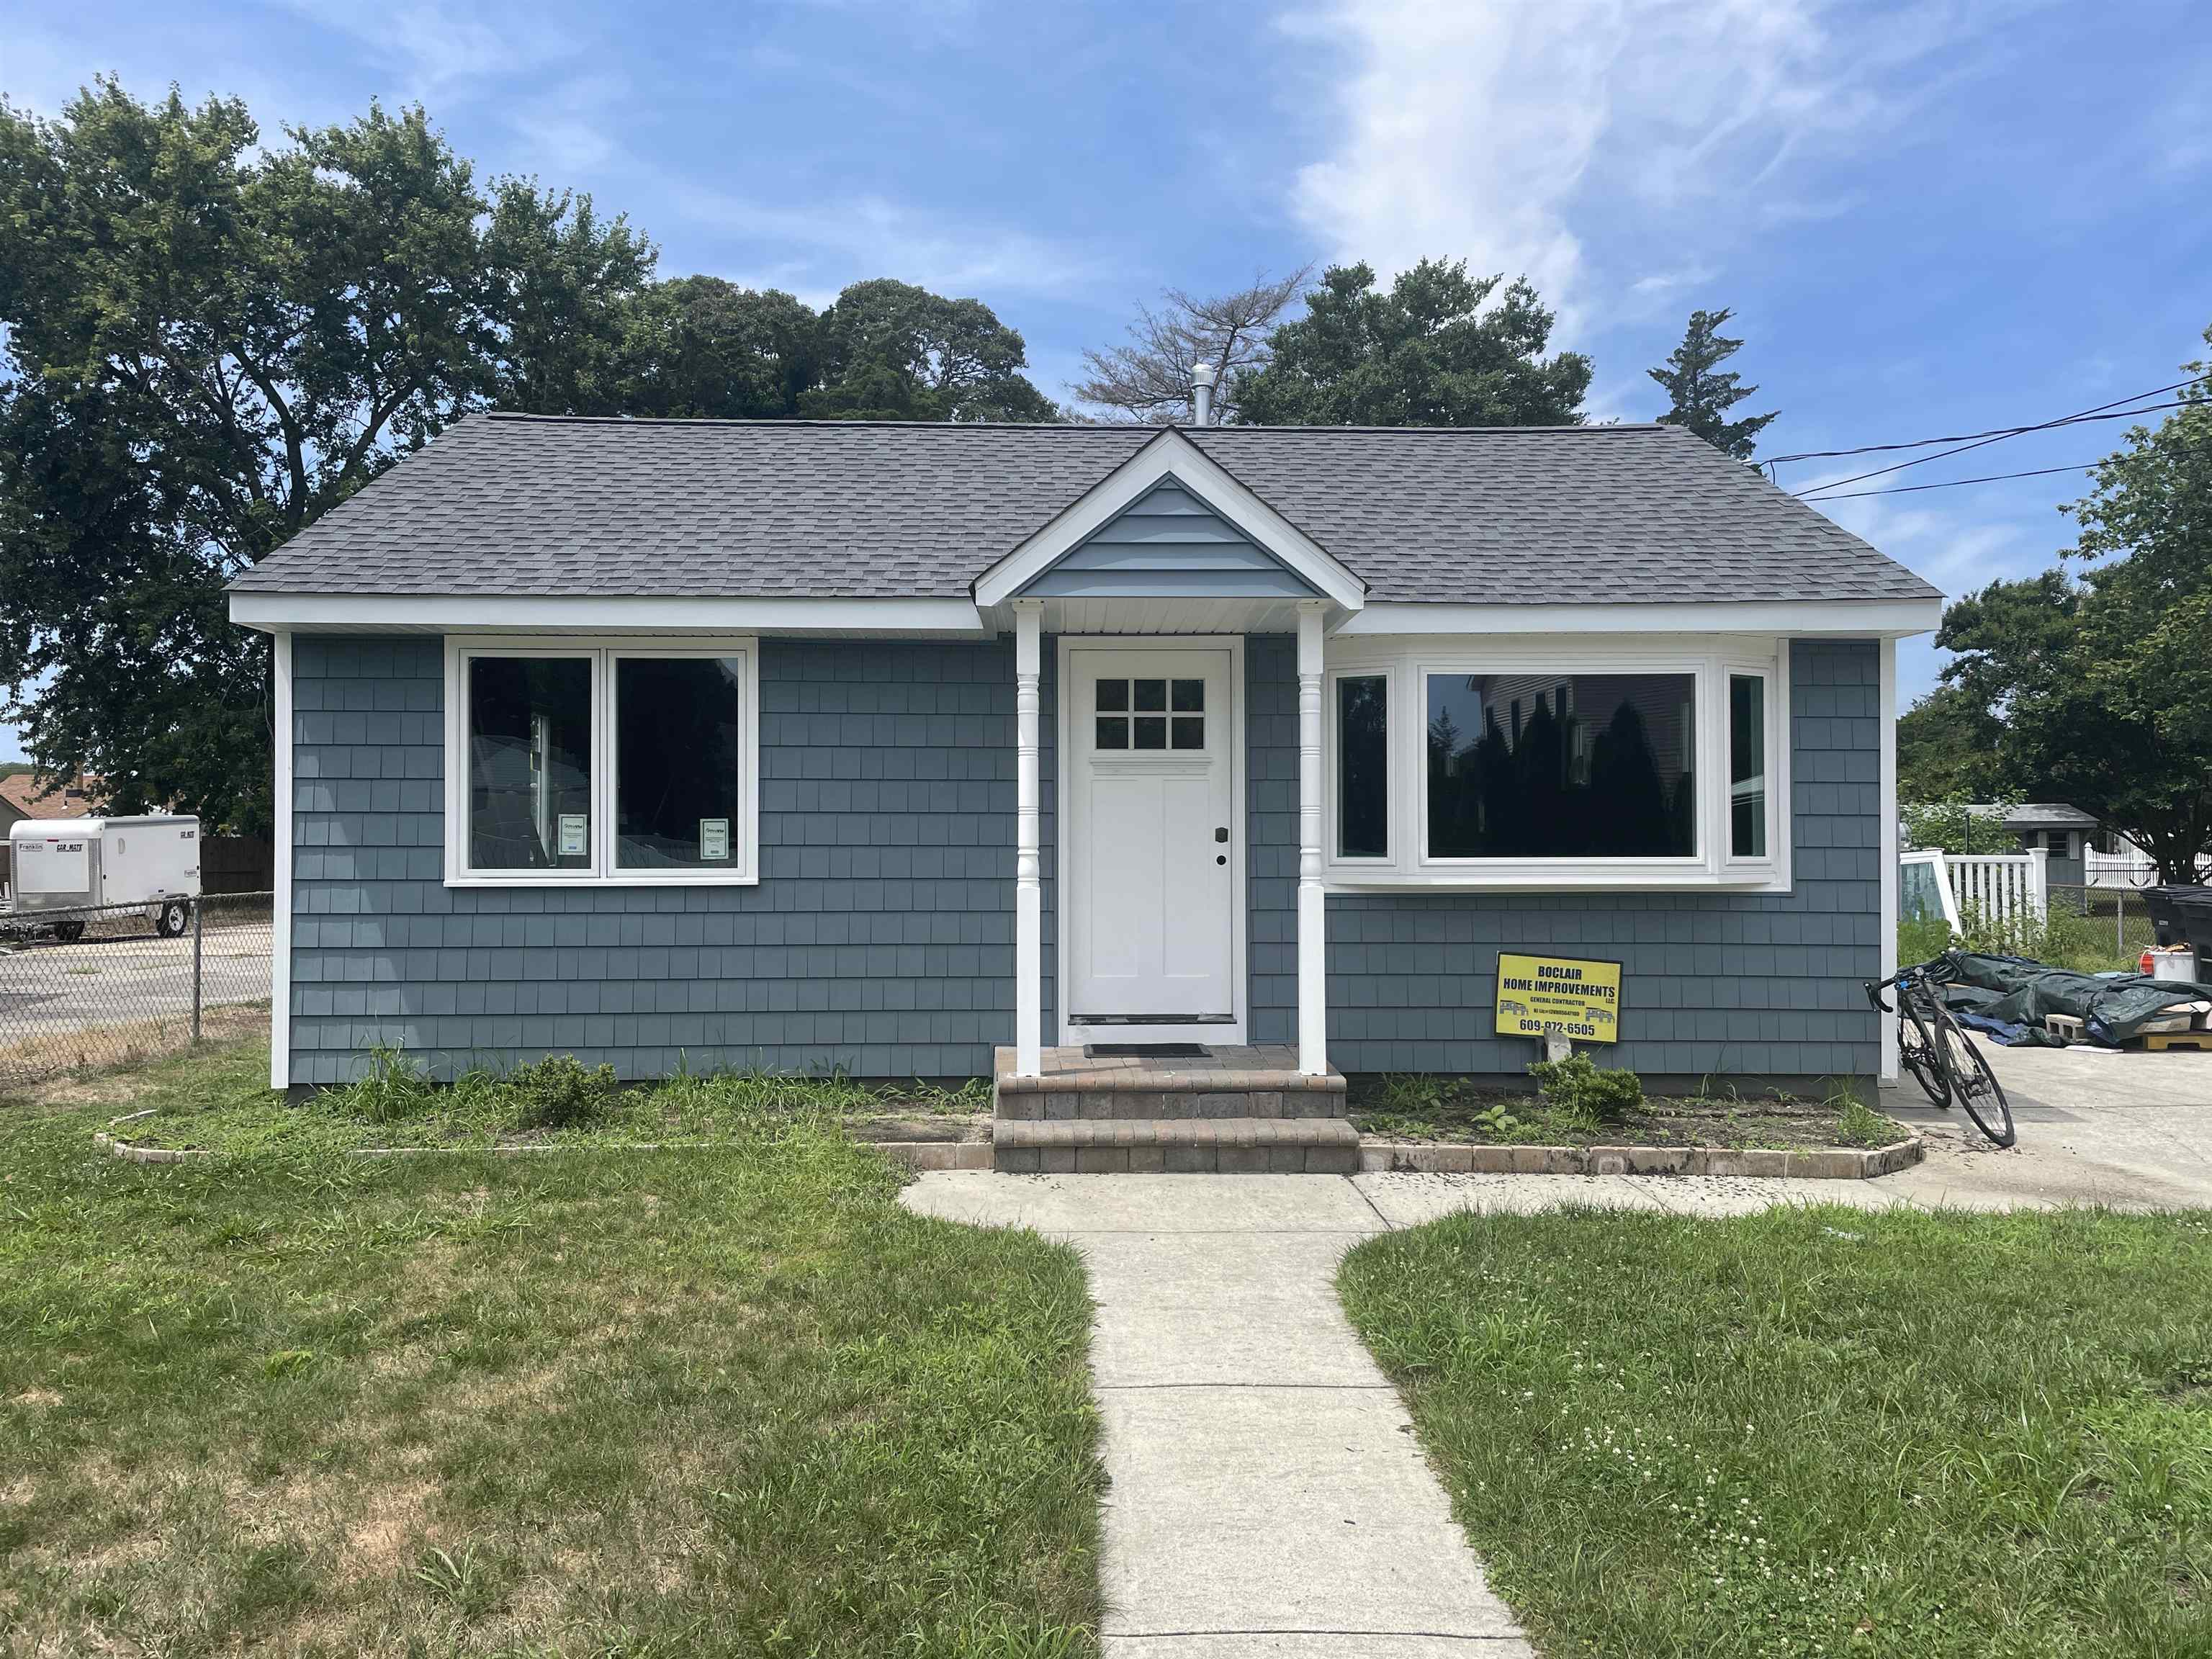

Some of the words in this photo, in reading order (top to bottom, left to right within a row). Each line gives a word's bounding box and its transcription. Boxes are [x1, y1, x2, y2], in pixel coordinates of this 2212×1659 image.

[1538, 966, 1583, 980] BOCLAIR
[1503, 978, 1532, 992] HOME
[1534, 980, 1615, 998] IMPROVEMENTS
[1552, 998, 1586, 1007] CONTRACTOR
